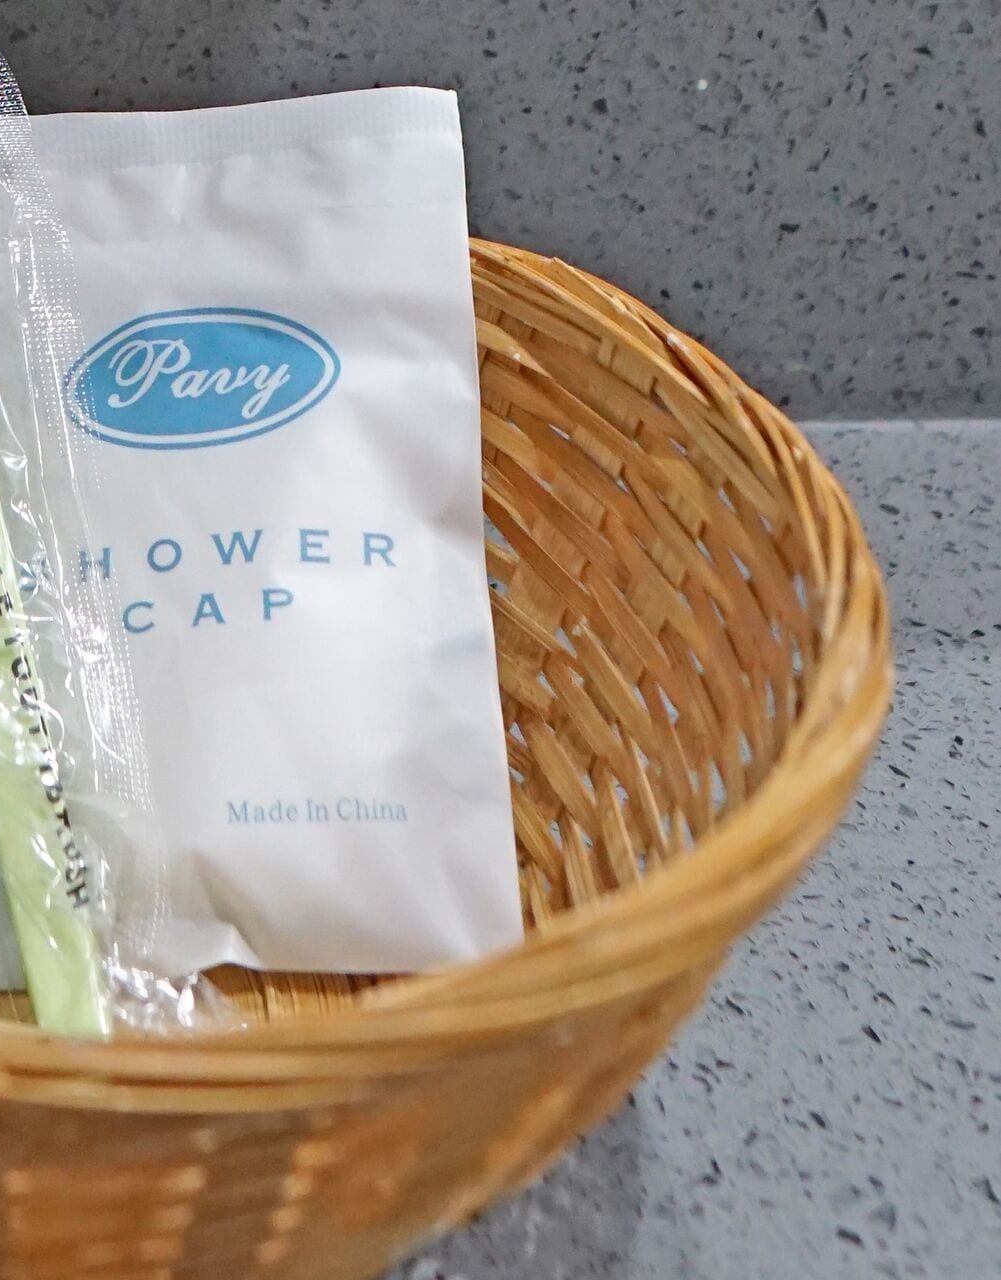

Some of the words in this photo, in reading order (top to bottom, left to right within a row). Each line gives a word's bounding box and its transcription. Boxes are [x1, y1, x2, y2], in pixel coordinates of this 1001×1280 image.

[107, 338, 290, 420] Pavy
[121, 588, 295, 635] CAP
[226, 799, 299, 824] Made
[304, 798, 330, 823] In
[336, 796, 408, 823] China
